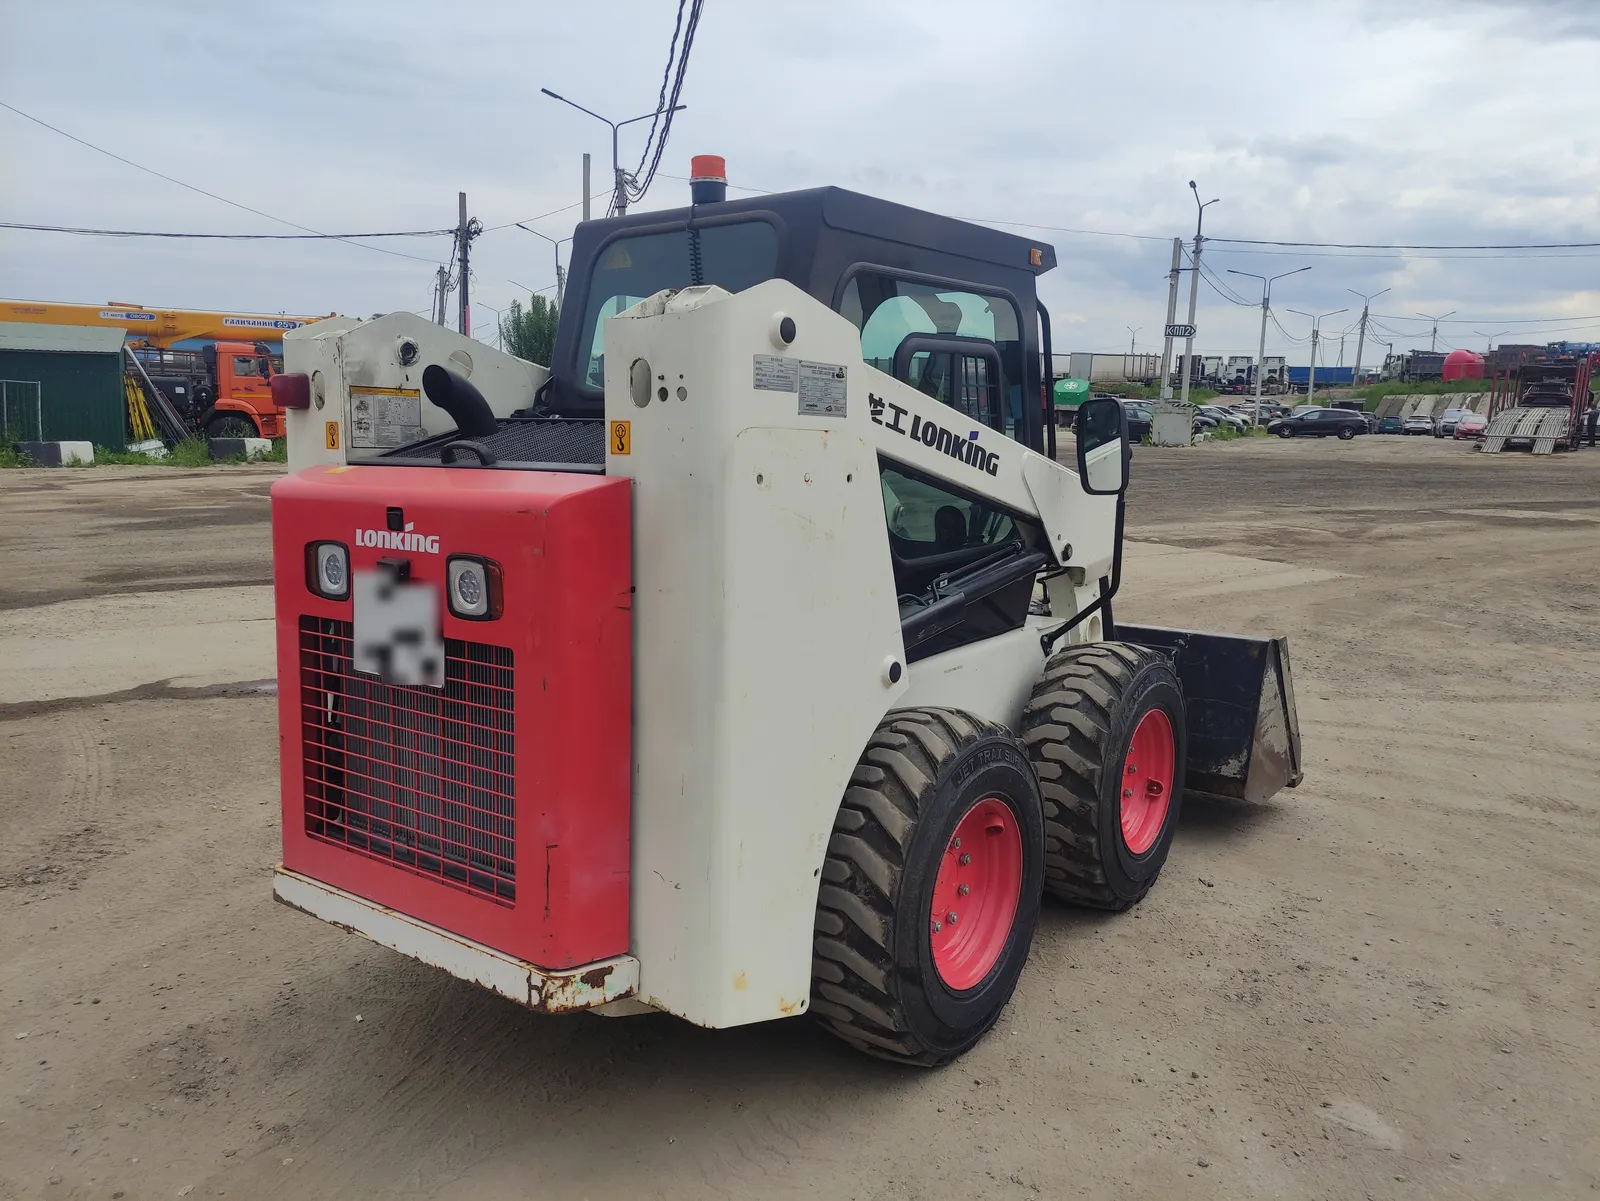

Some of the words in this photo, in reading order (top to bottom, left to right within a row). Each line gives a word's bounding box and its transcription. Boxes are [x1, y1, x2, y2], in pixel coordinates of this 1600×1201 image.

[910, 414, 1000, 477] LONKING
[355, 522, 440, 554] LONKING
[957, 758, 975, 784] JET
[977, 748, 1003, 765] TRAX
